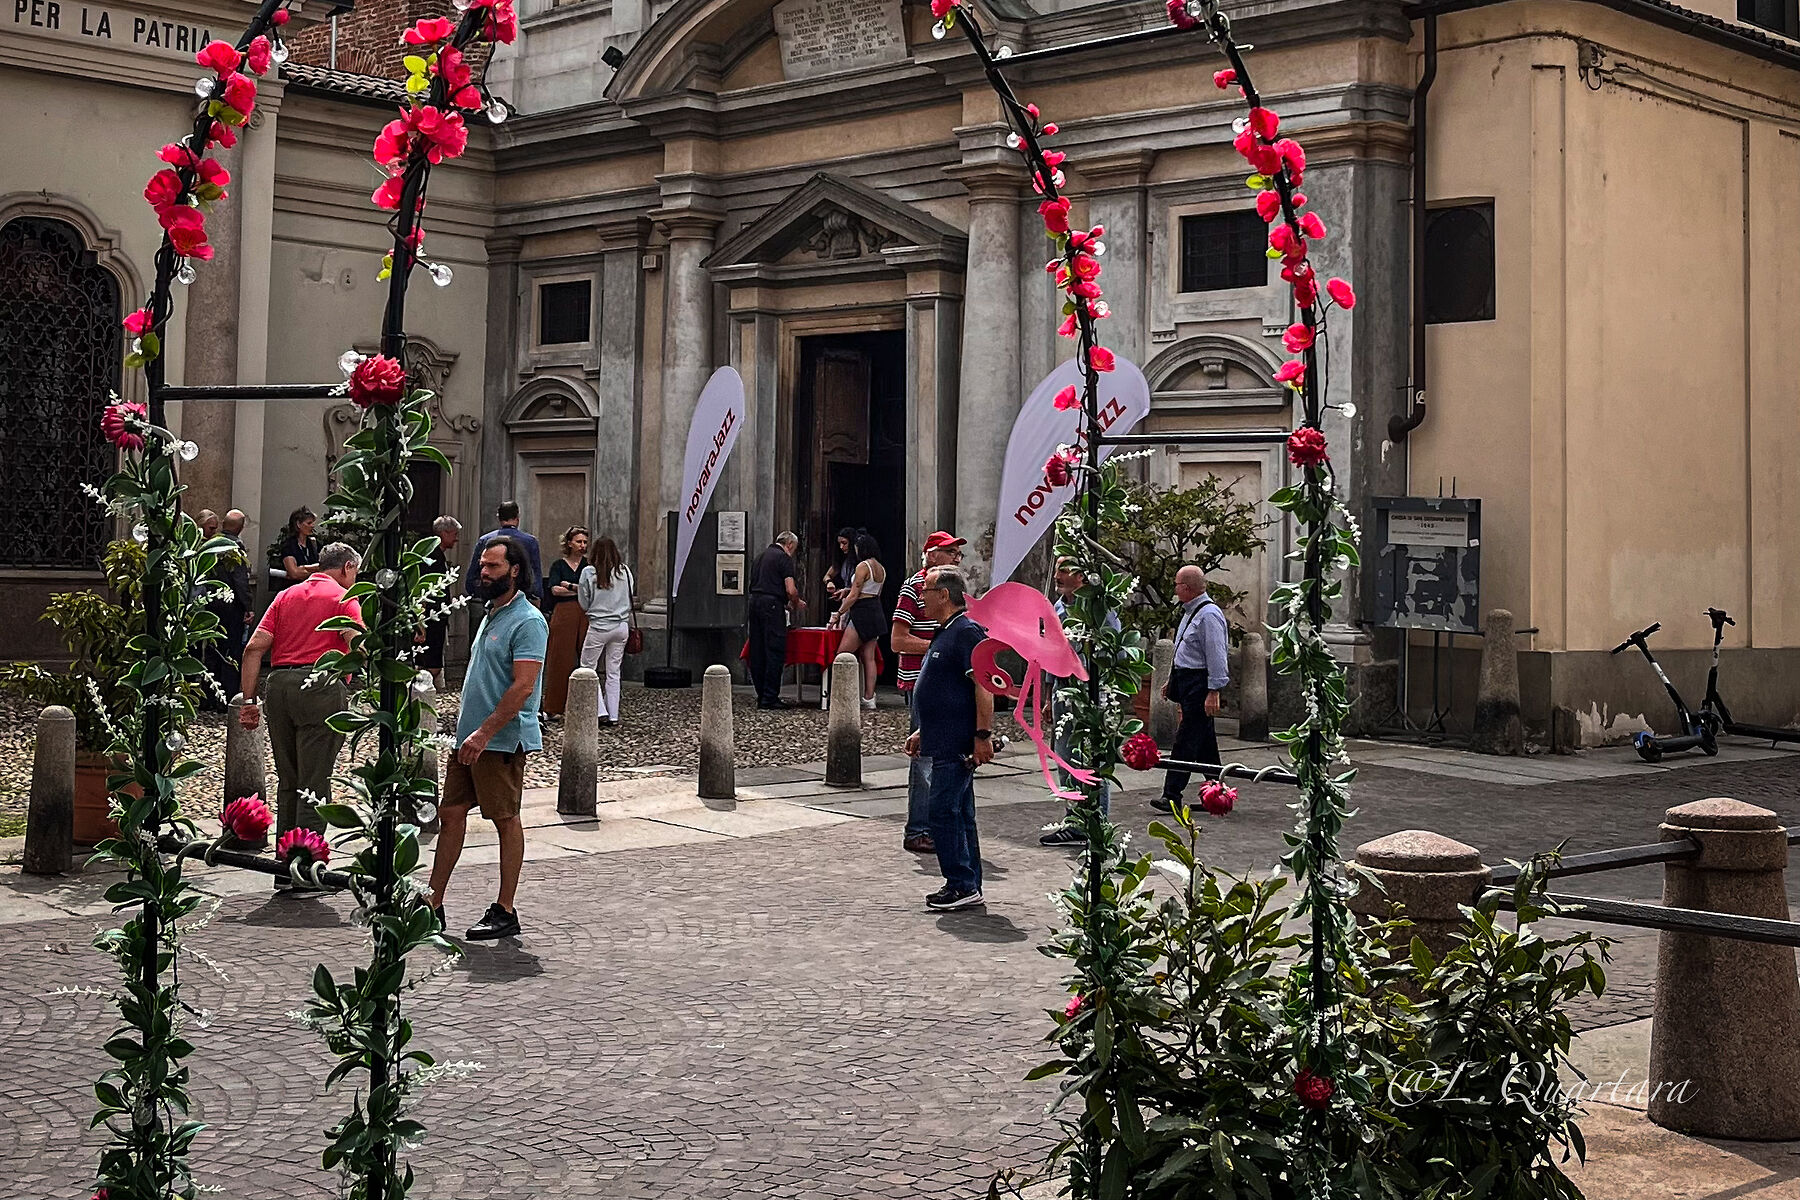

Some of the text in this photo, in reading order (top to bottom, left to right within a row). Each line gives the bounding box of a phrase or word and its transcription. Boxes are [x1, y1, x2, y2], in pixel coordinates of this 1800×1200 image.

[80, 7, 112, 39] LA
[133, 17, 212, 54] PATRIA
[685, 407, 736, 525] novarajazz
